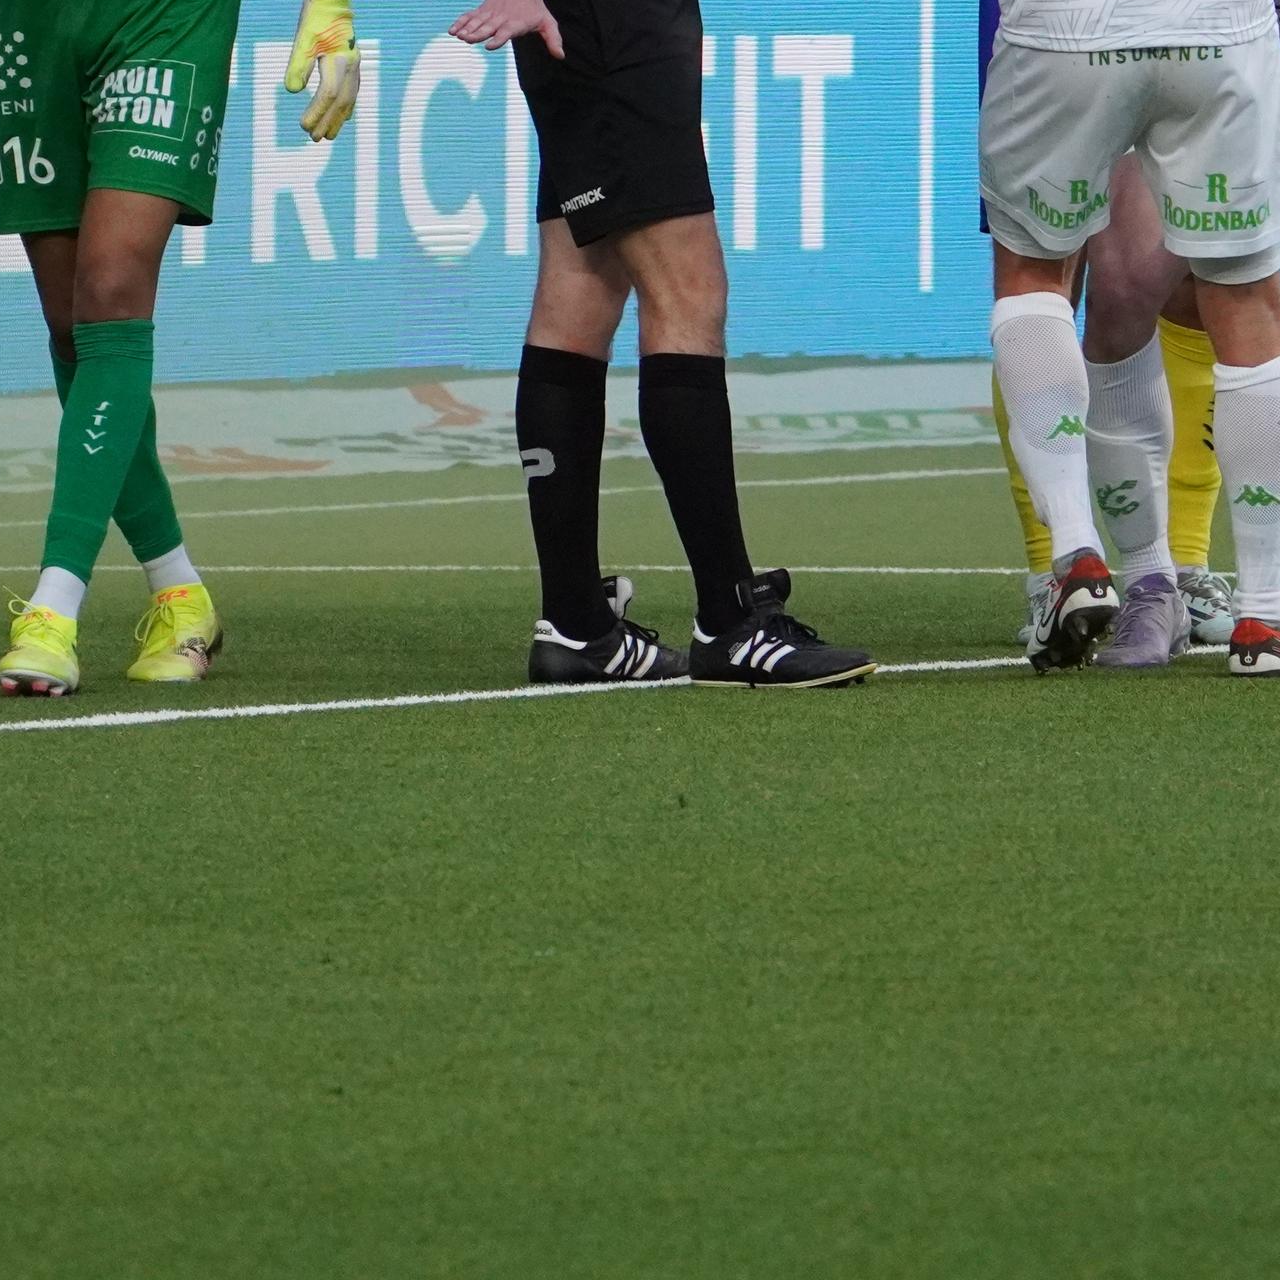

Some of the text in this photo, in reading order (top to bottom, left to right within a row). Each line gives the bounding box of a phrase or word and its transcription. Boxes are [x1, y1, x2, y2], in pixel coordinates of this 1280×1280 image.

[1088, 46, 1223, 66] INSURANCE
[3, 136, 56, 185] 16
[128, 145, 180, 166] OLYMPIC
[565, 187, 605, 213] PATRICK
[1067, 179, 1090, 205] R
[1206, 173, 1230, 204] R
